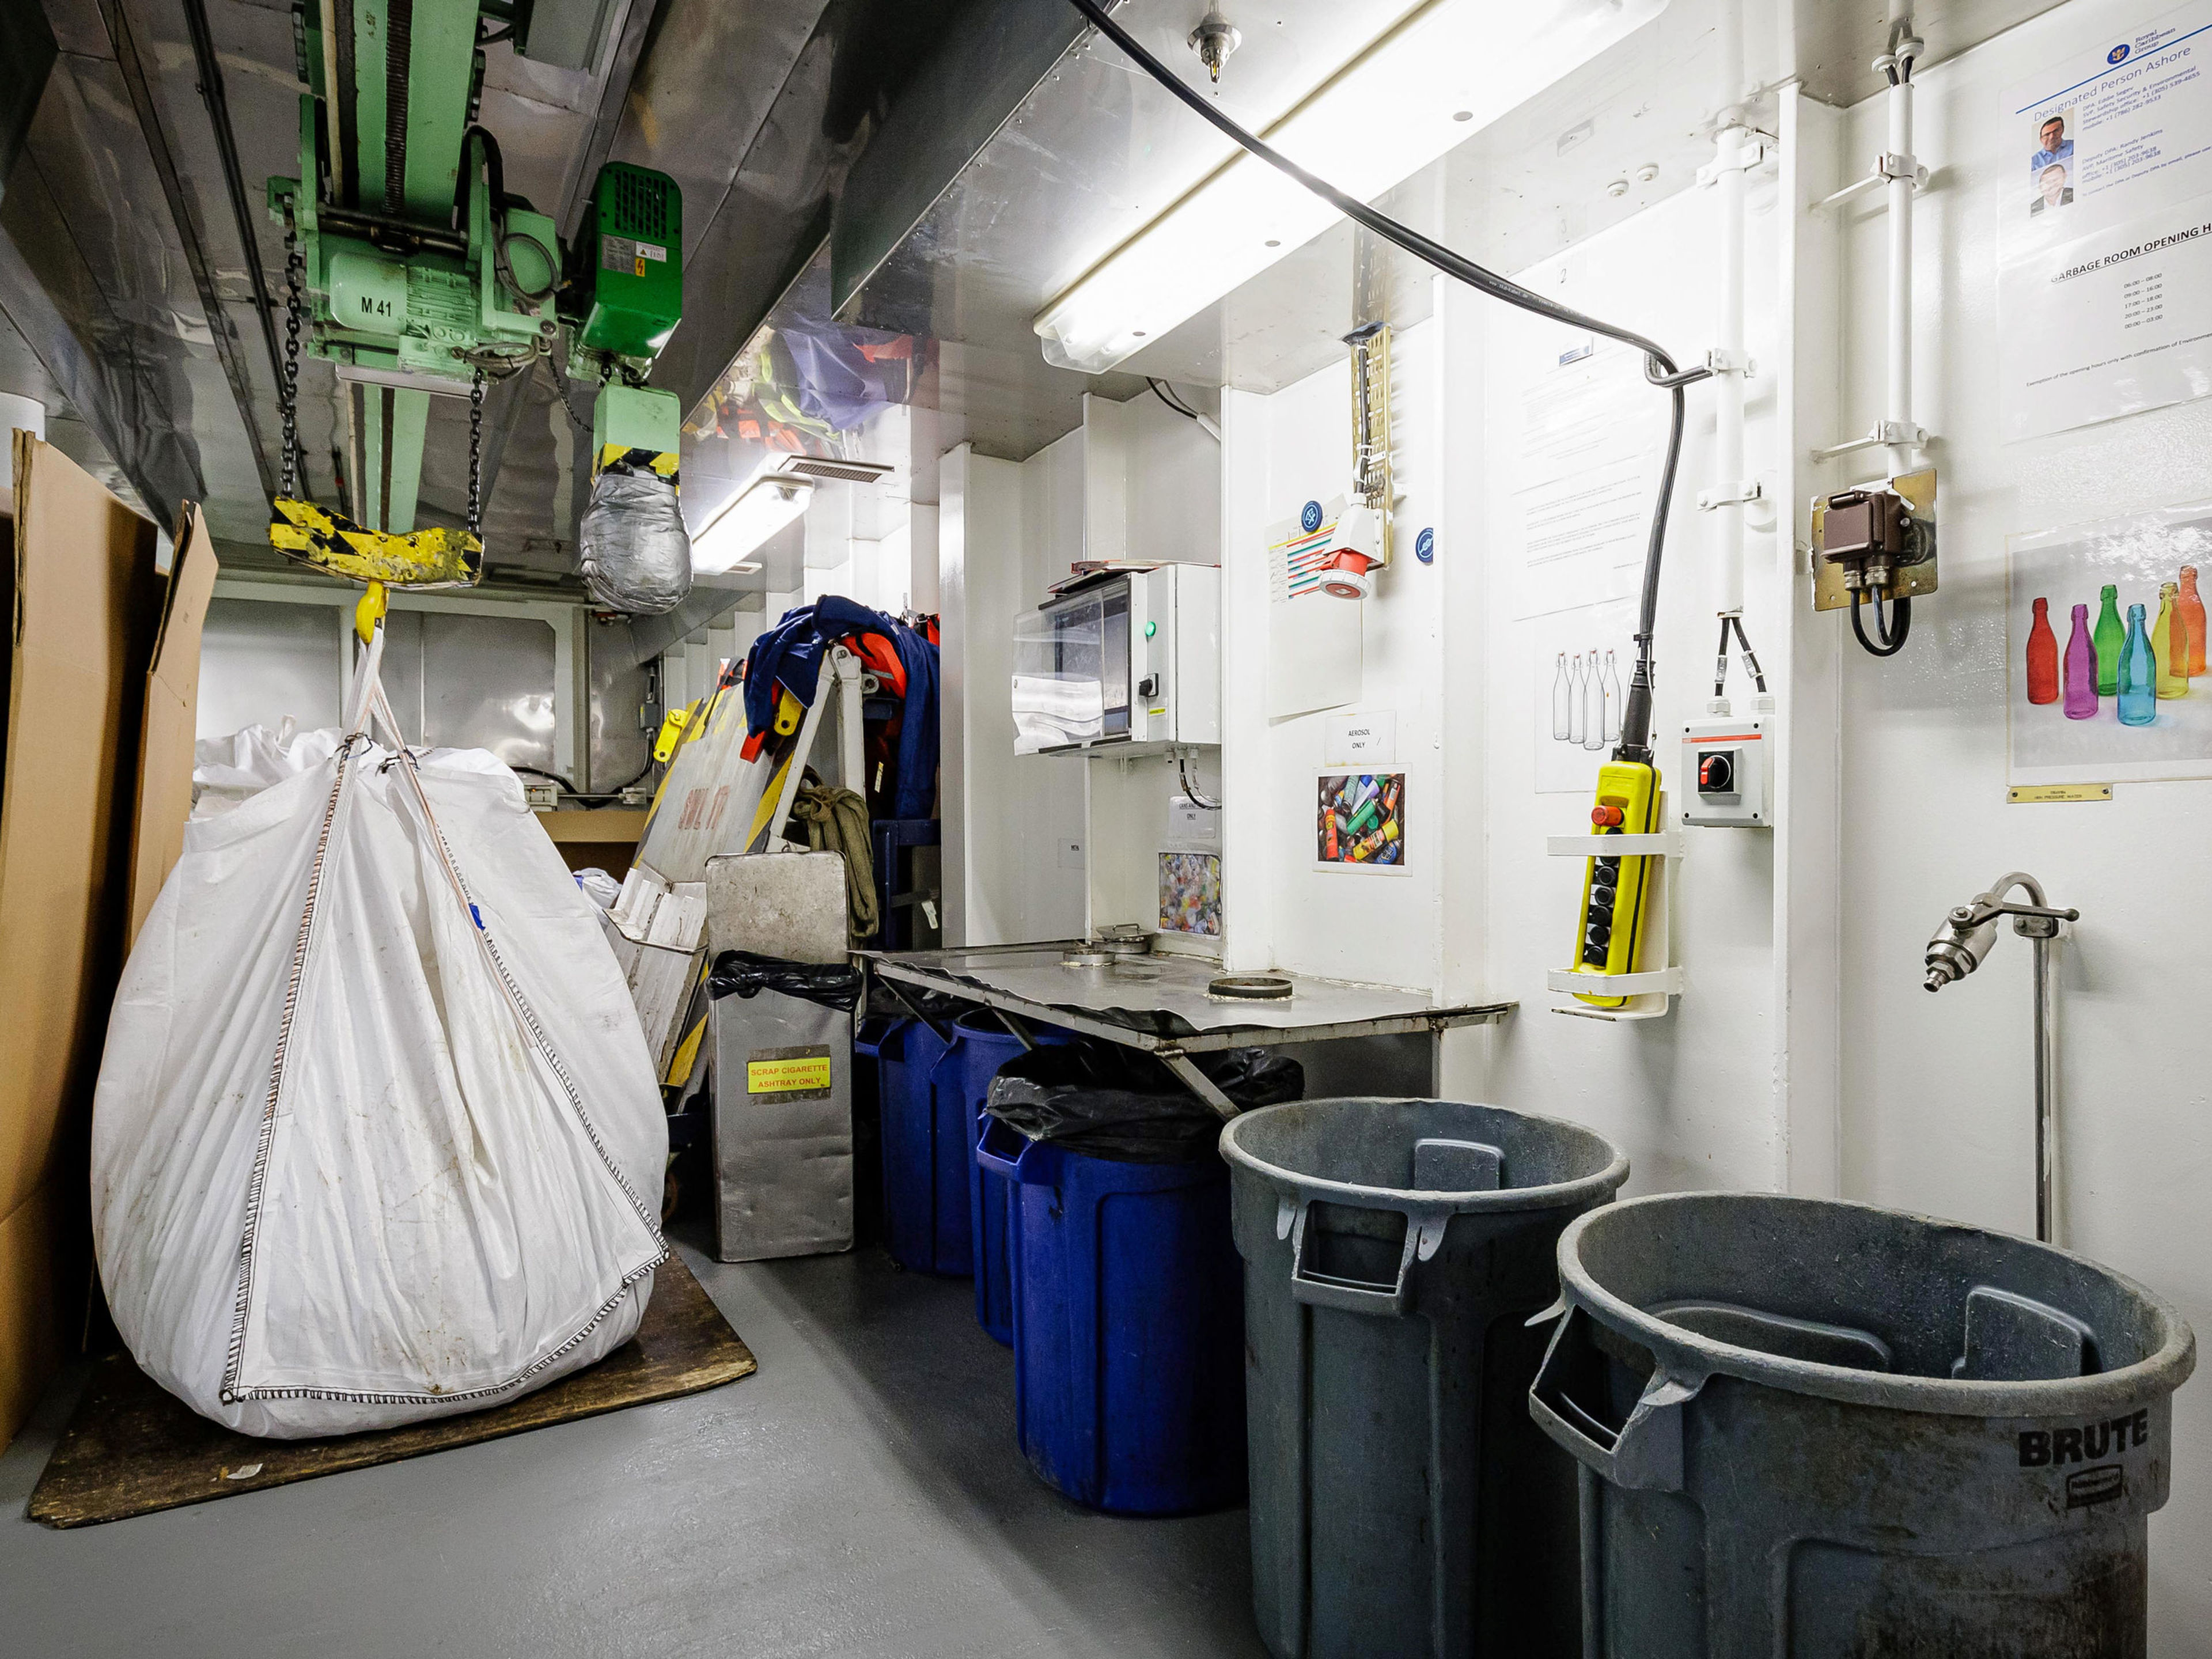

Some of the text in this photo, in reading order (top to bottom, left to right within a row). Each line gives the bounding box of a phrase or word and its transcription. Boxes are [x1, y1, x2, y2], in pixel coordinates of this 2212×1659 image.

[2135, 29, 2157, 43] Royal
[2135, 28, 2176, 48] Caribbean
[2135, 41, 2159, 54] Group
[2034, 47, 2191, 122] Designated Person Ashore
[2117, 90, 2141, 103] Security
[2149, 66, 2196, 89] Environmental
[2125, 144, 2143, 155] Safety
[2051, 259, 2101, 283] GARBAGE
[2104, 246, 2141, 265] ROOM
[2143, 227, 2199, 252] OPENING
[361, 297, 392, 317] M 41
[2133, 344, 2171, 357] confirmation
[1348, 729, 1370, 737] AEROSOL
[1352, 741, 1365, 749] ONLY
[751, 1065, 827, 1076] SCRAP CIGARETTE
[758, 1079, 797, 1088] ASHTRAY
[2019, 1408, 2148, 1467] BRUTE
